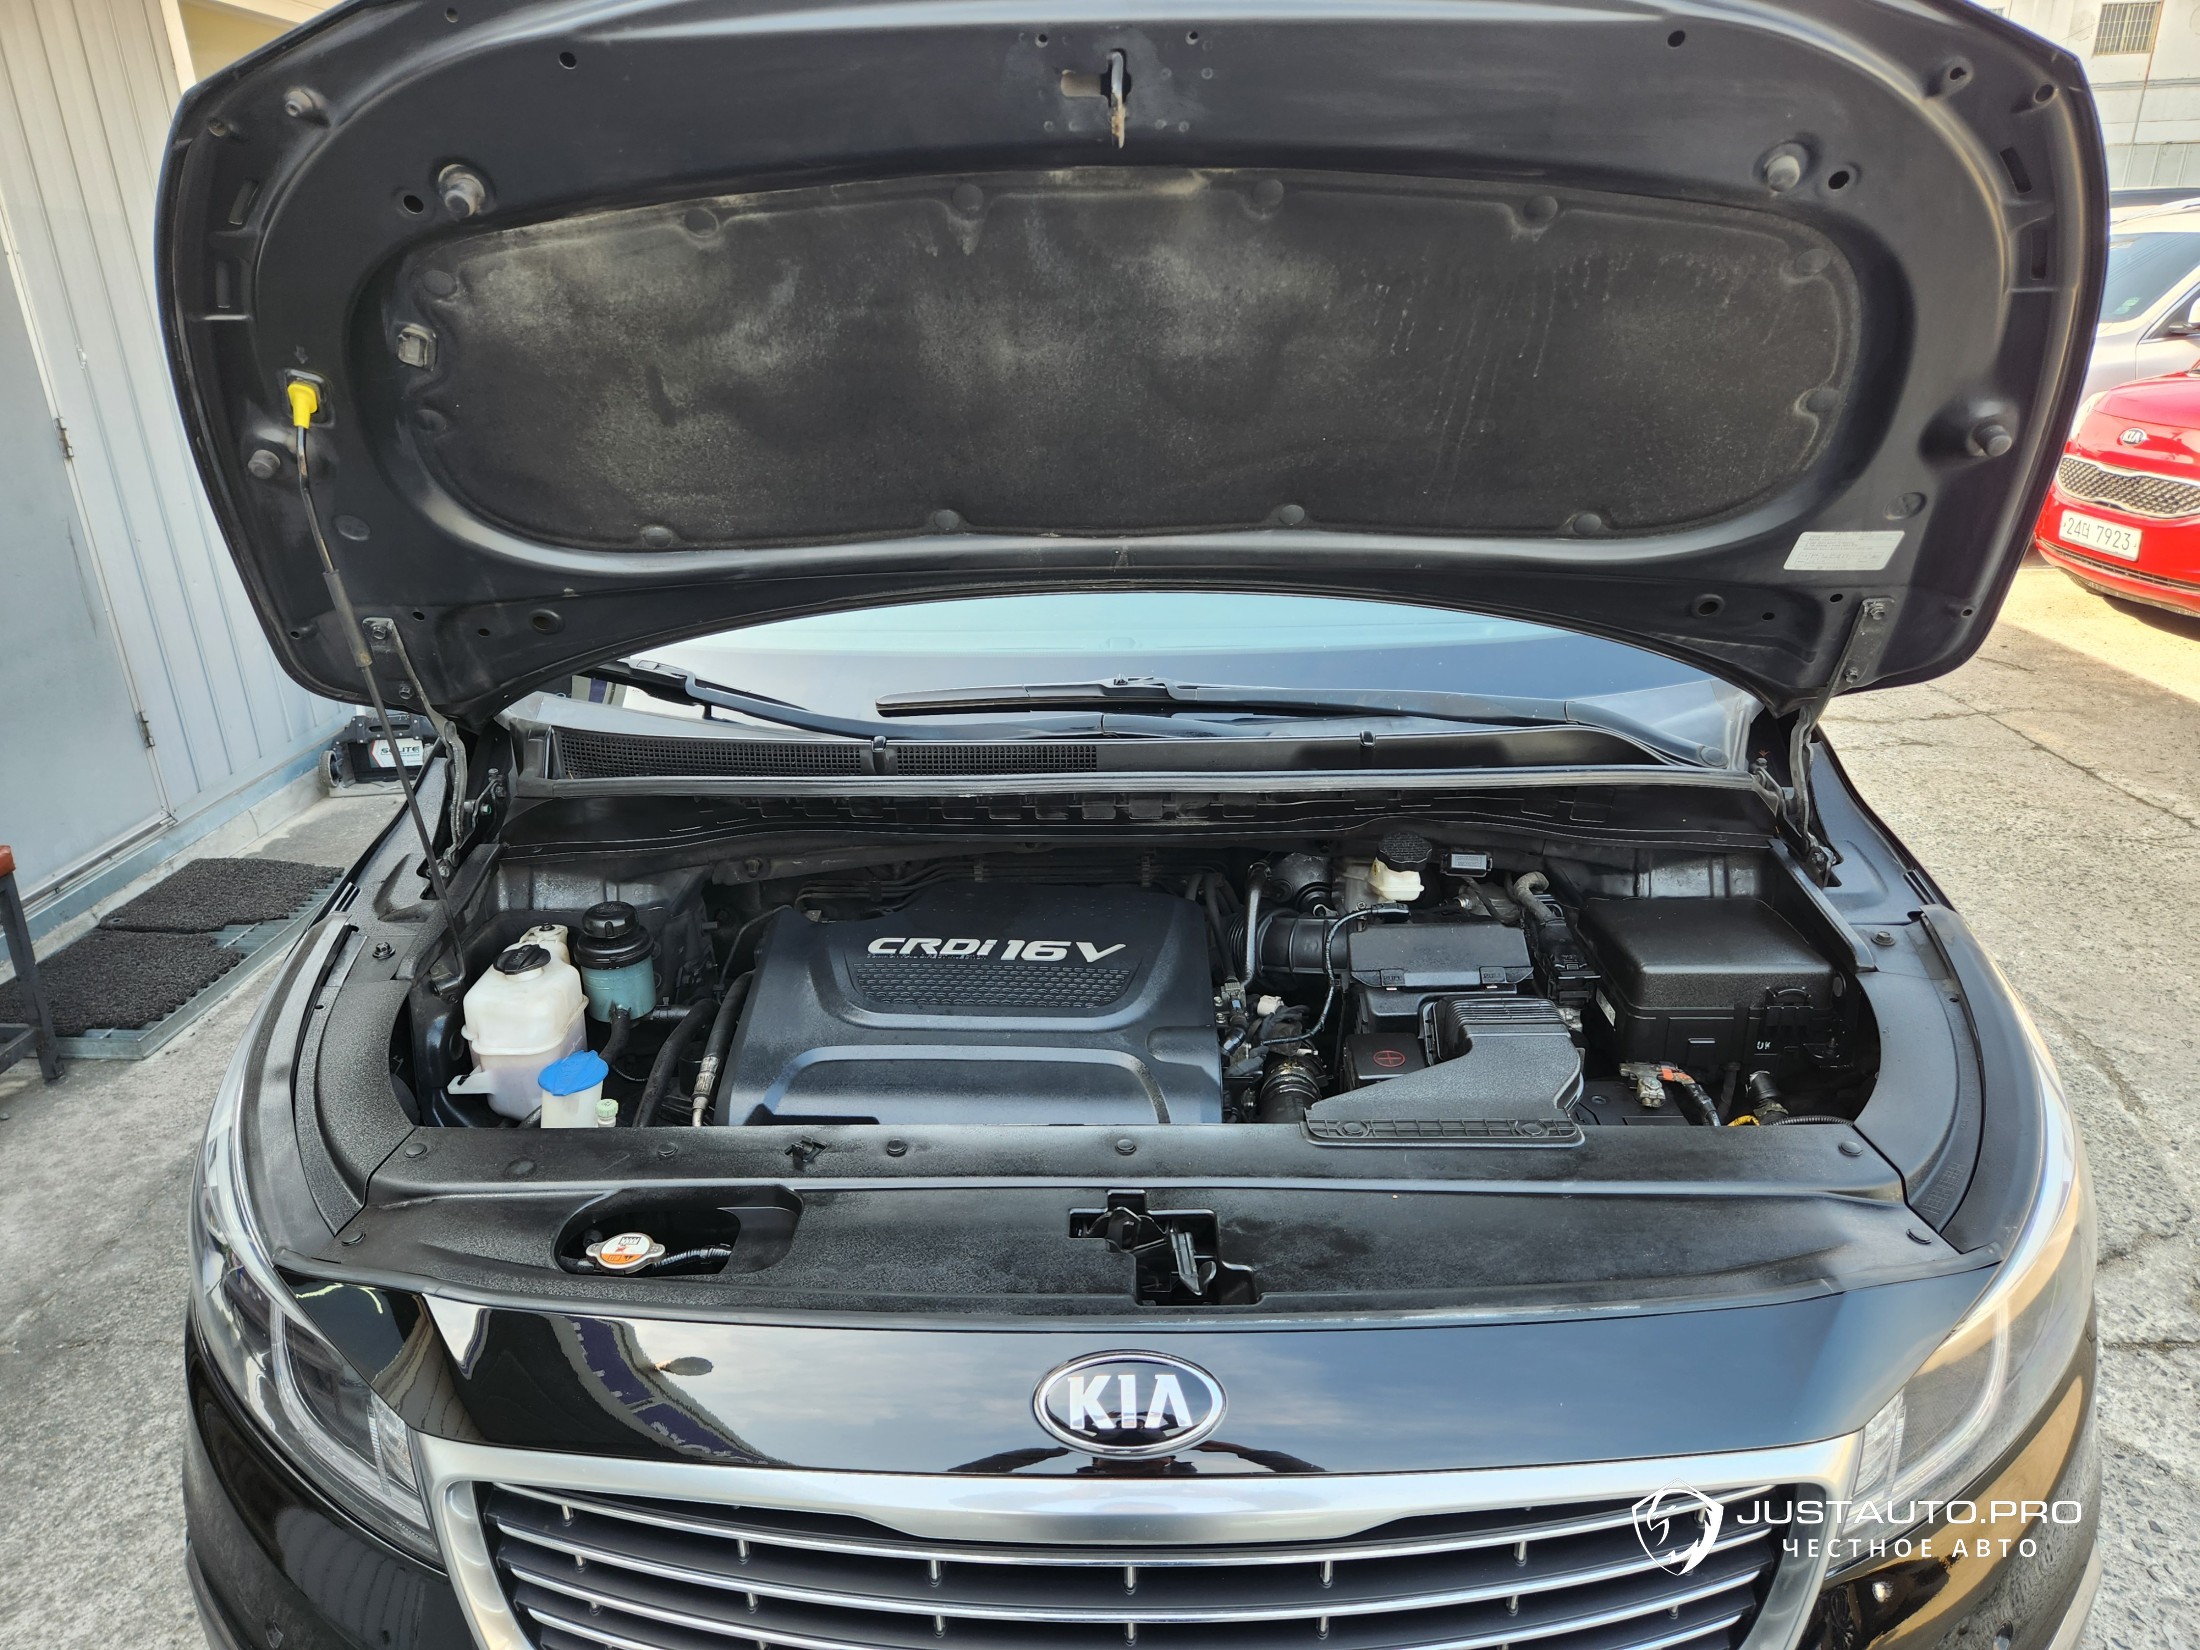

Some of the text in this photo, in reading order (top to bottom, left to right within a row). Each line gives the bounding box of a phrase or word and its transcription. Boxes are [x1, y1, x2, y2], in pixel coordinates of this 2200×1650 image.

[2097, 525, 2131, 551] 7923
[1000, 939, 1127, 963] 16V
[1067, 1374, 1193, 1430] KIA
